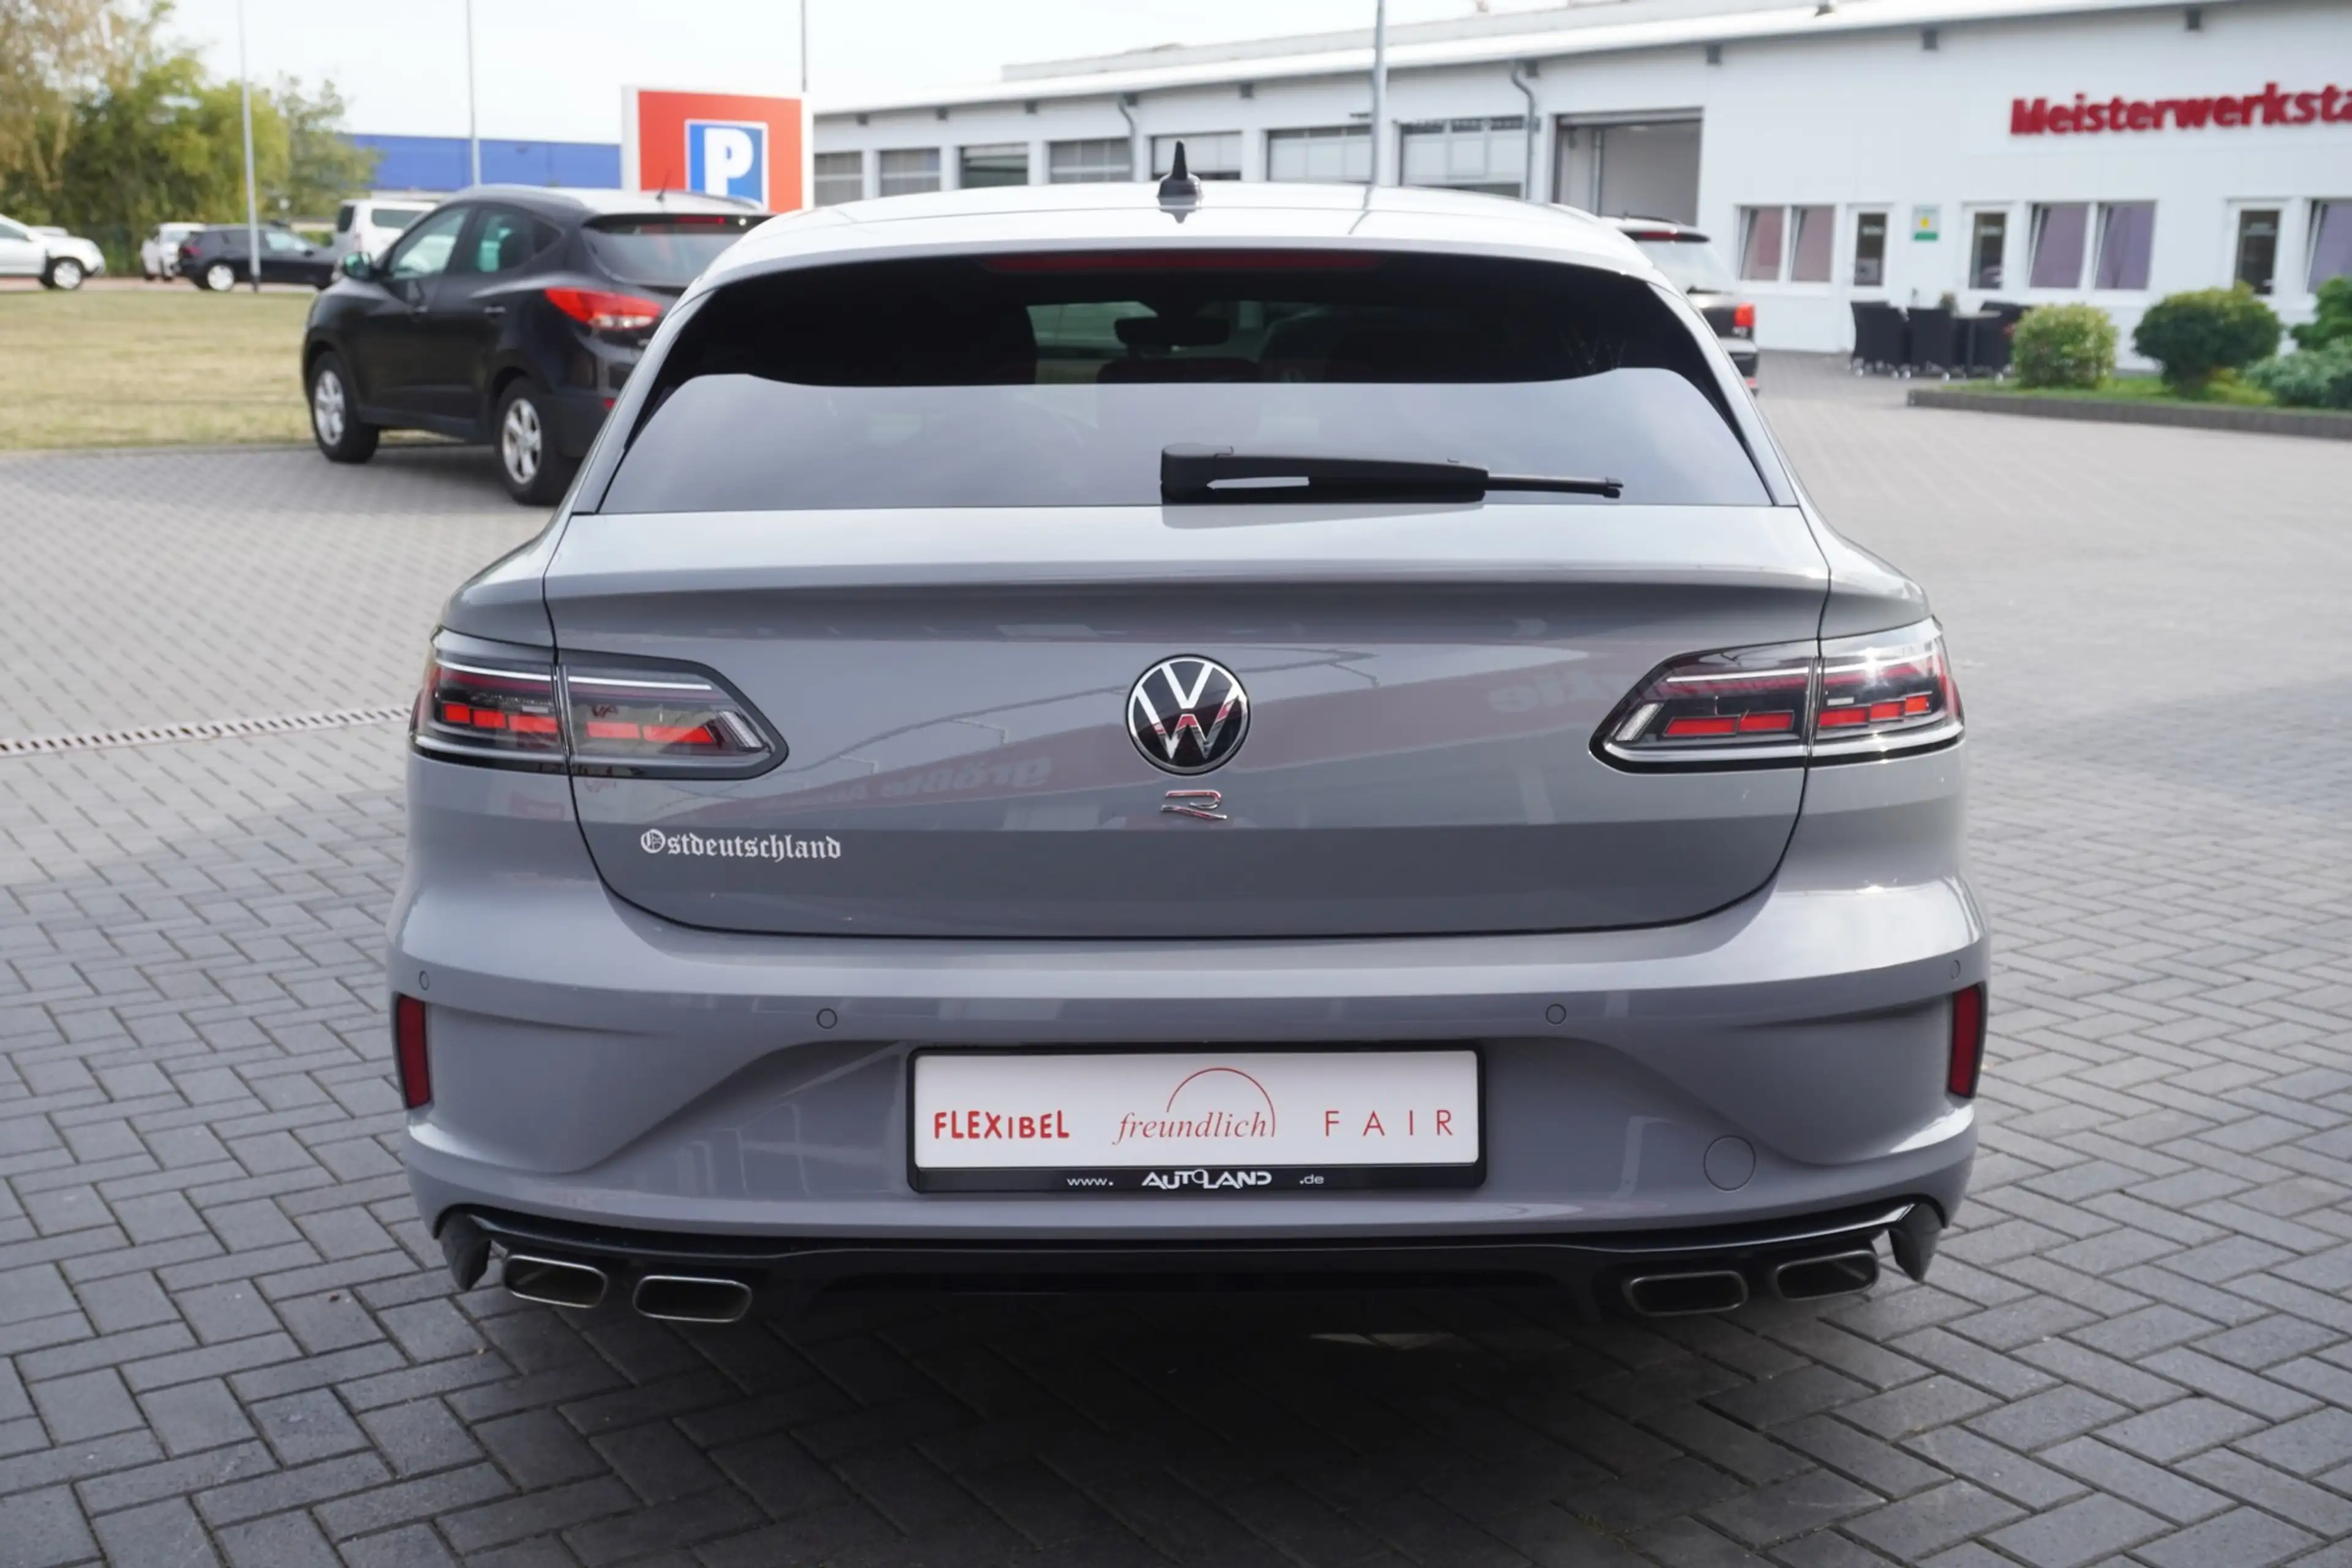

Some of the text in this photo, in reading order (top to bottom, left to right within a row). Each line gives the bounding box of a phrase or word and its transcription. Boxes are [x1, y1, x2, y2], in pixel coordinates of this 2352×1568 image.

[704, 126, 753, 196] P
[640, 828, 841, 862] Ostdeutschland
[933, 1109, 1453, 1145] FLEXIBEL freundlich FAIR
[1066, 1167, 1325, 1190] www. AUTOLAND .de
